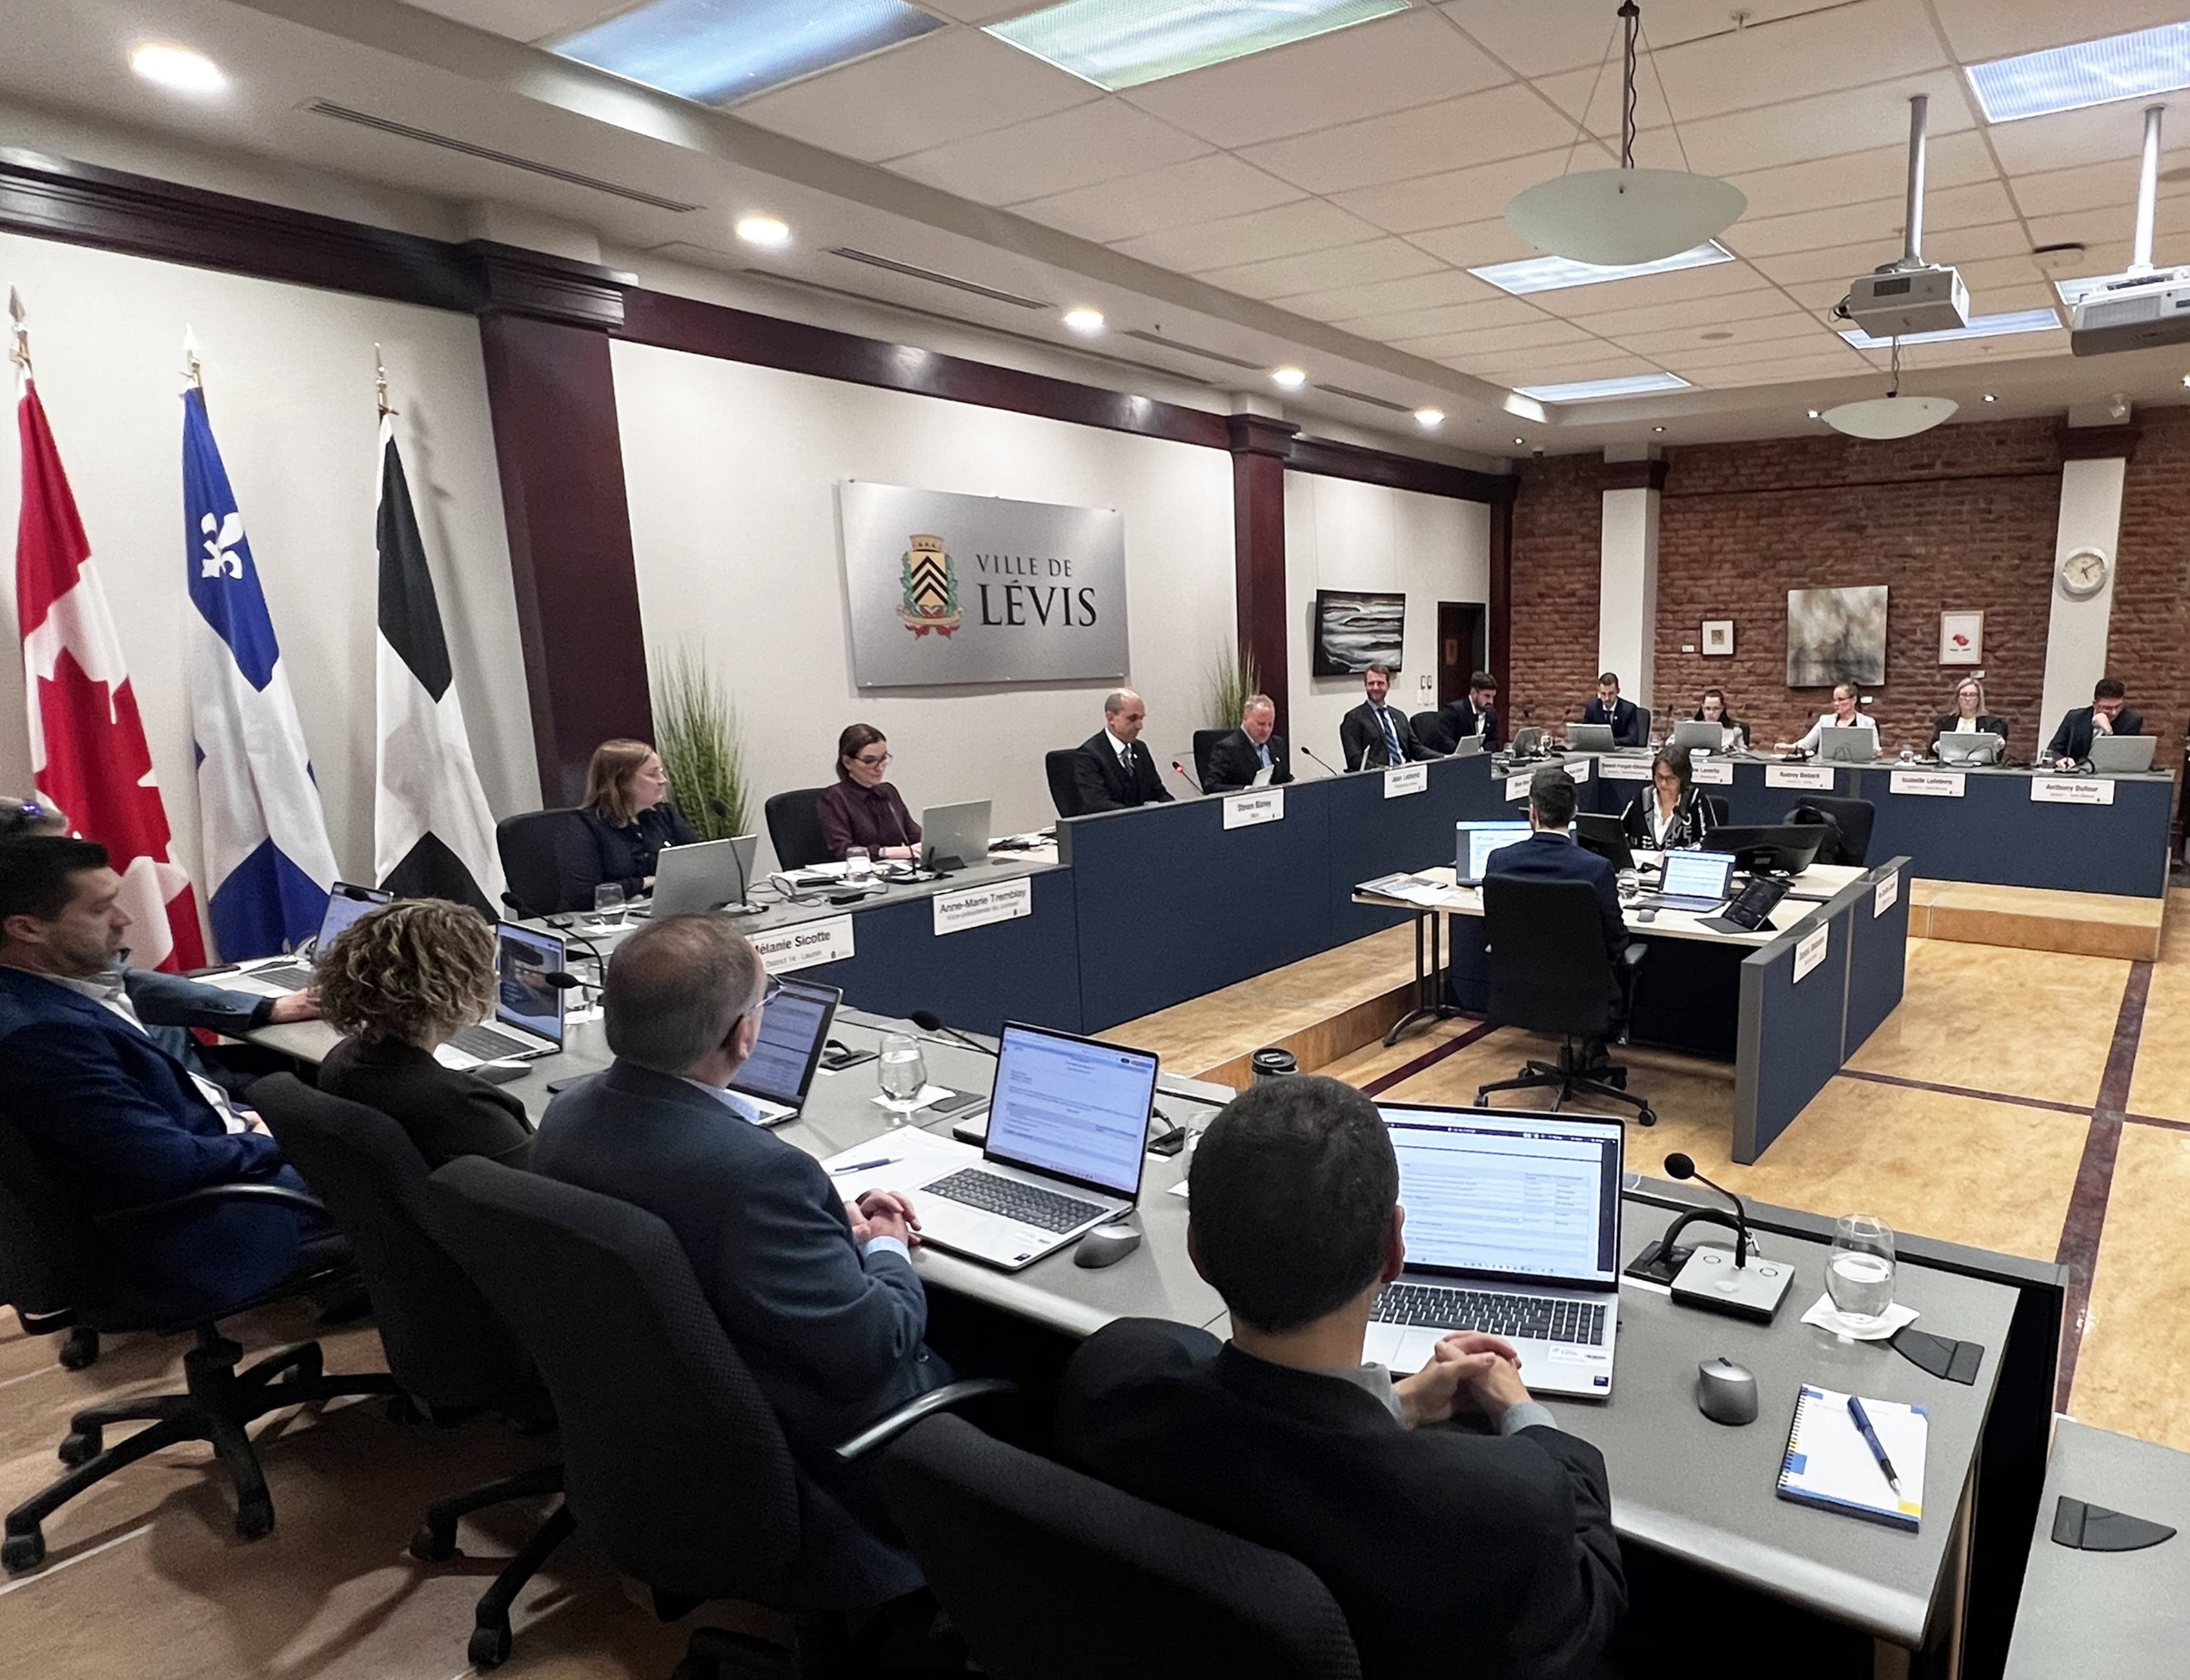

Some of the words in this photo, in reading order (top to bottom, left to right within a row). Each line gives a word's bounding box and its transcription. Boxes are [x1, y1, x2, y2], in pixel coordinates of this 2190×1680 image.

[975, 553, 1038, 576] VILLE
[1048, 558, 1073, 578] DE
[976, 579, 1097, 627] LÉVIS
[940, 897, 988, 914] Anne-Marie
[990, 889, 1026, 903] Tremblay
[795, 931, 831, 948] Sicotte
